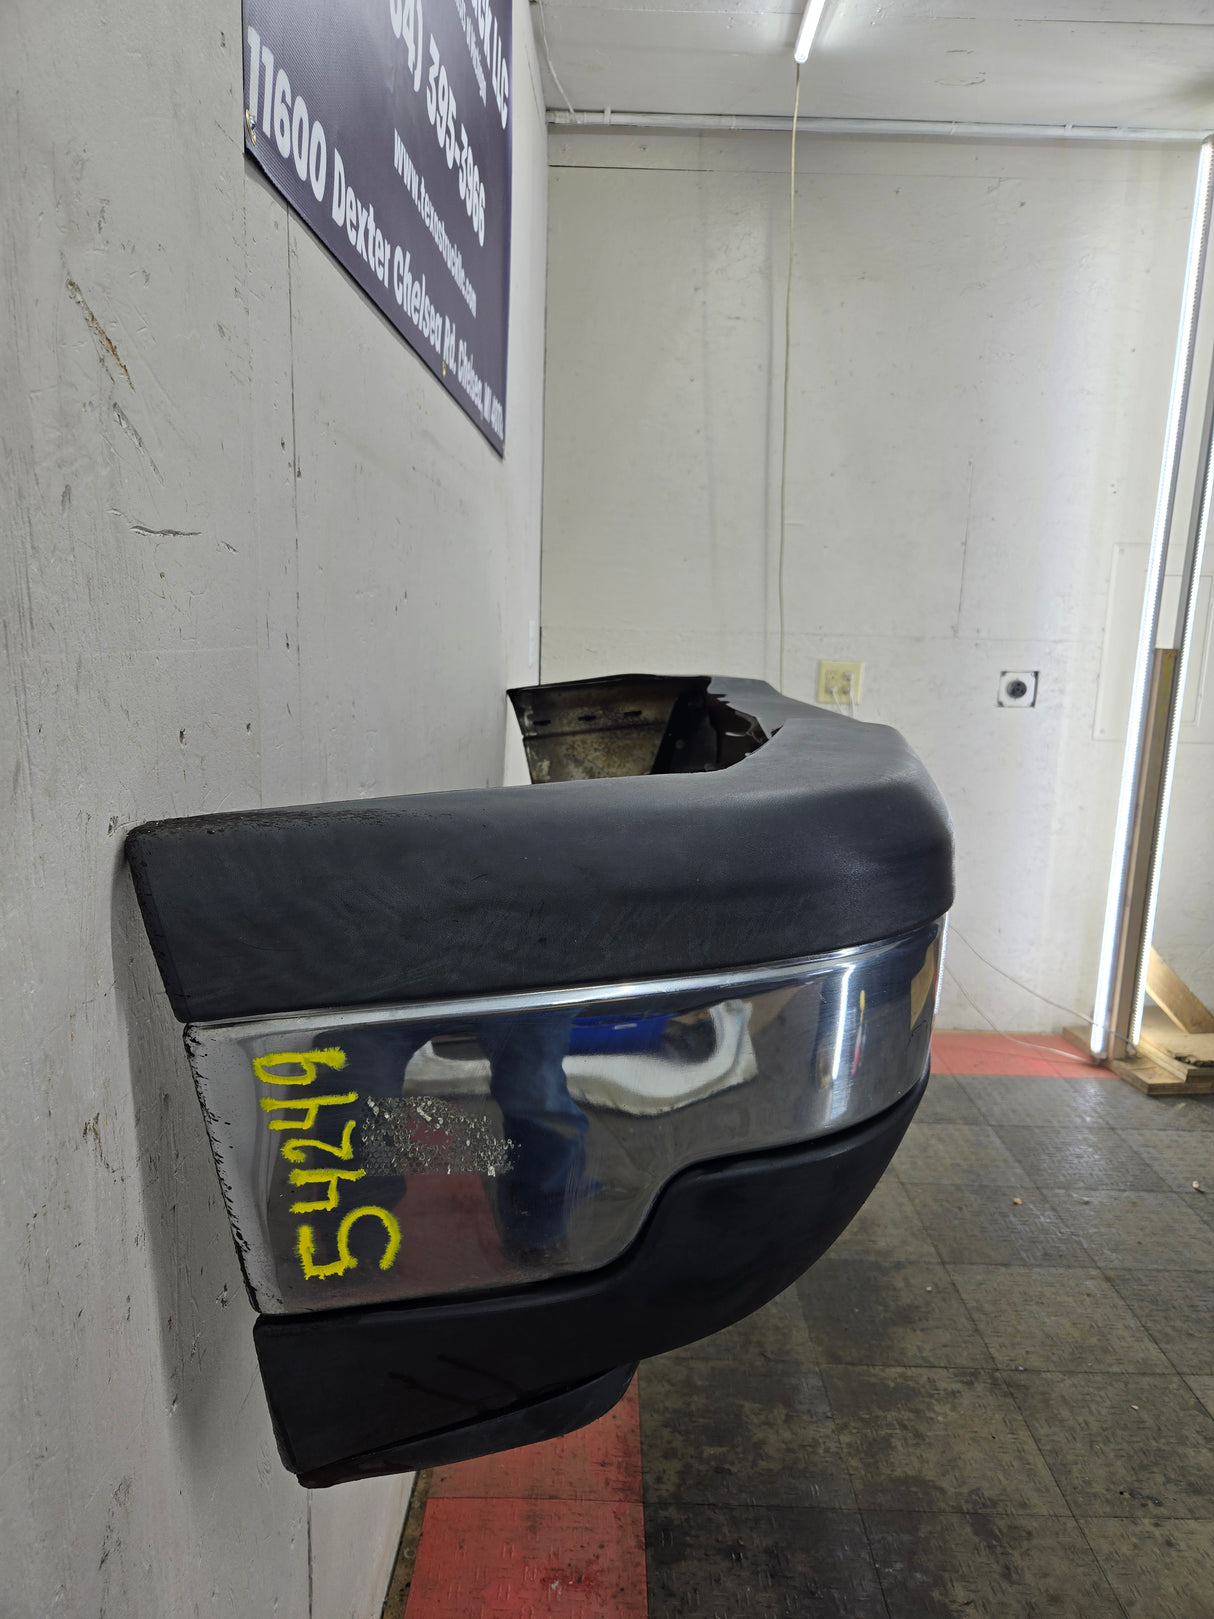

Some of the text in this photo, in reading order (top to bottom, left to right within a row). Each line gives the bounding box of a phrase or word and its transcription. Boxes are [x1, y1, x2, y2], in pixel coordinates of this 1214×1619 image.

[427, 33, 485, 247] 395-3966
[492, 16, 509, 129] LLC
[248, 25, 327, 202] 11600
[332, 147, 391, 288] Dexter
[393, 245, 443, 354] Chelsea
[253, 1047, 402, 1280] 54249
